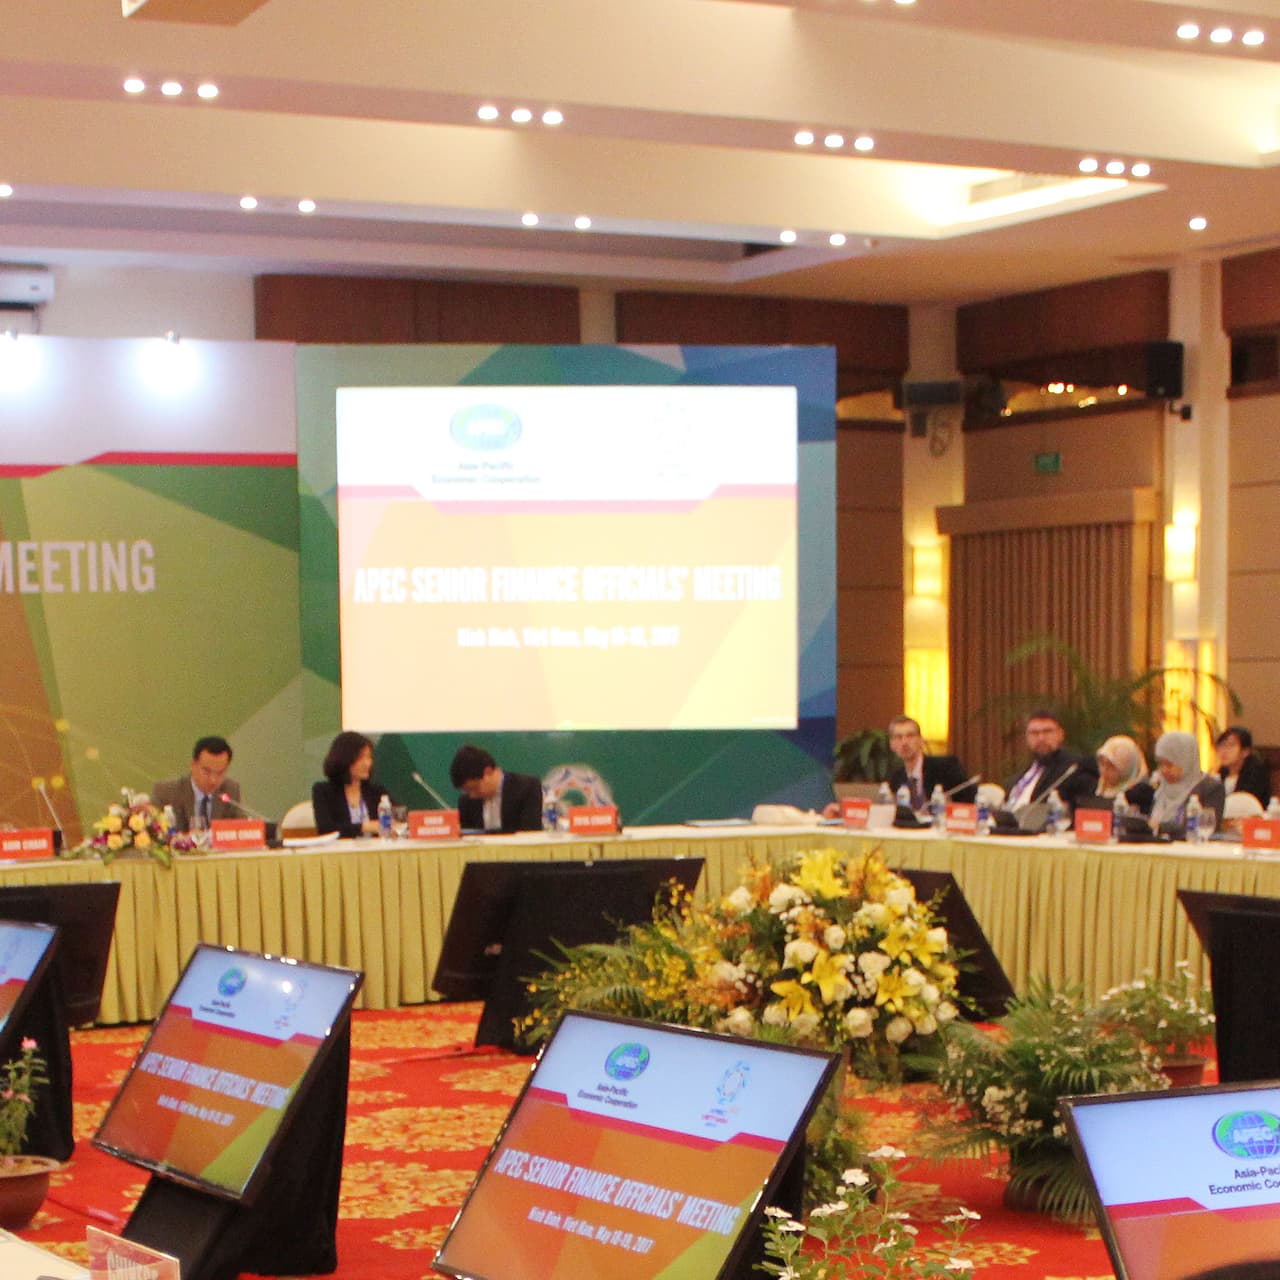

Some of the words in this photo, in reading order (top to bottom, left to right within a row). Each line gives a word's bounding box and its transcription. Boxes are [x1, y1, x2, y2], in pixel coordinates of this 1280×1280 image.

[354, 567, 408, 602] APEC
[411, 567, 488, 602] SENIOR
[491, 566, 579, 602] FINANCE
[693, 565, 782, 601] MEETING
[494, 1148, 529, 1178] APEC
[523, 1155, 571, 1190] SENIOR
[564, 1166, 621, 1203] FINANCE
[613, 1179, 684, 1219] OFFICIALS'
[676, 1196, 742, 1236] MEETING
[1209, 1179, 1262, 1196] Economic
